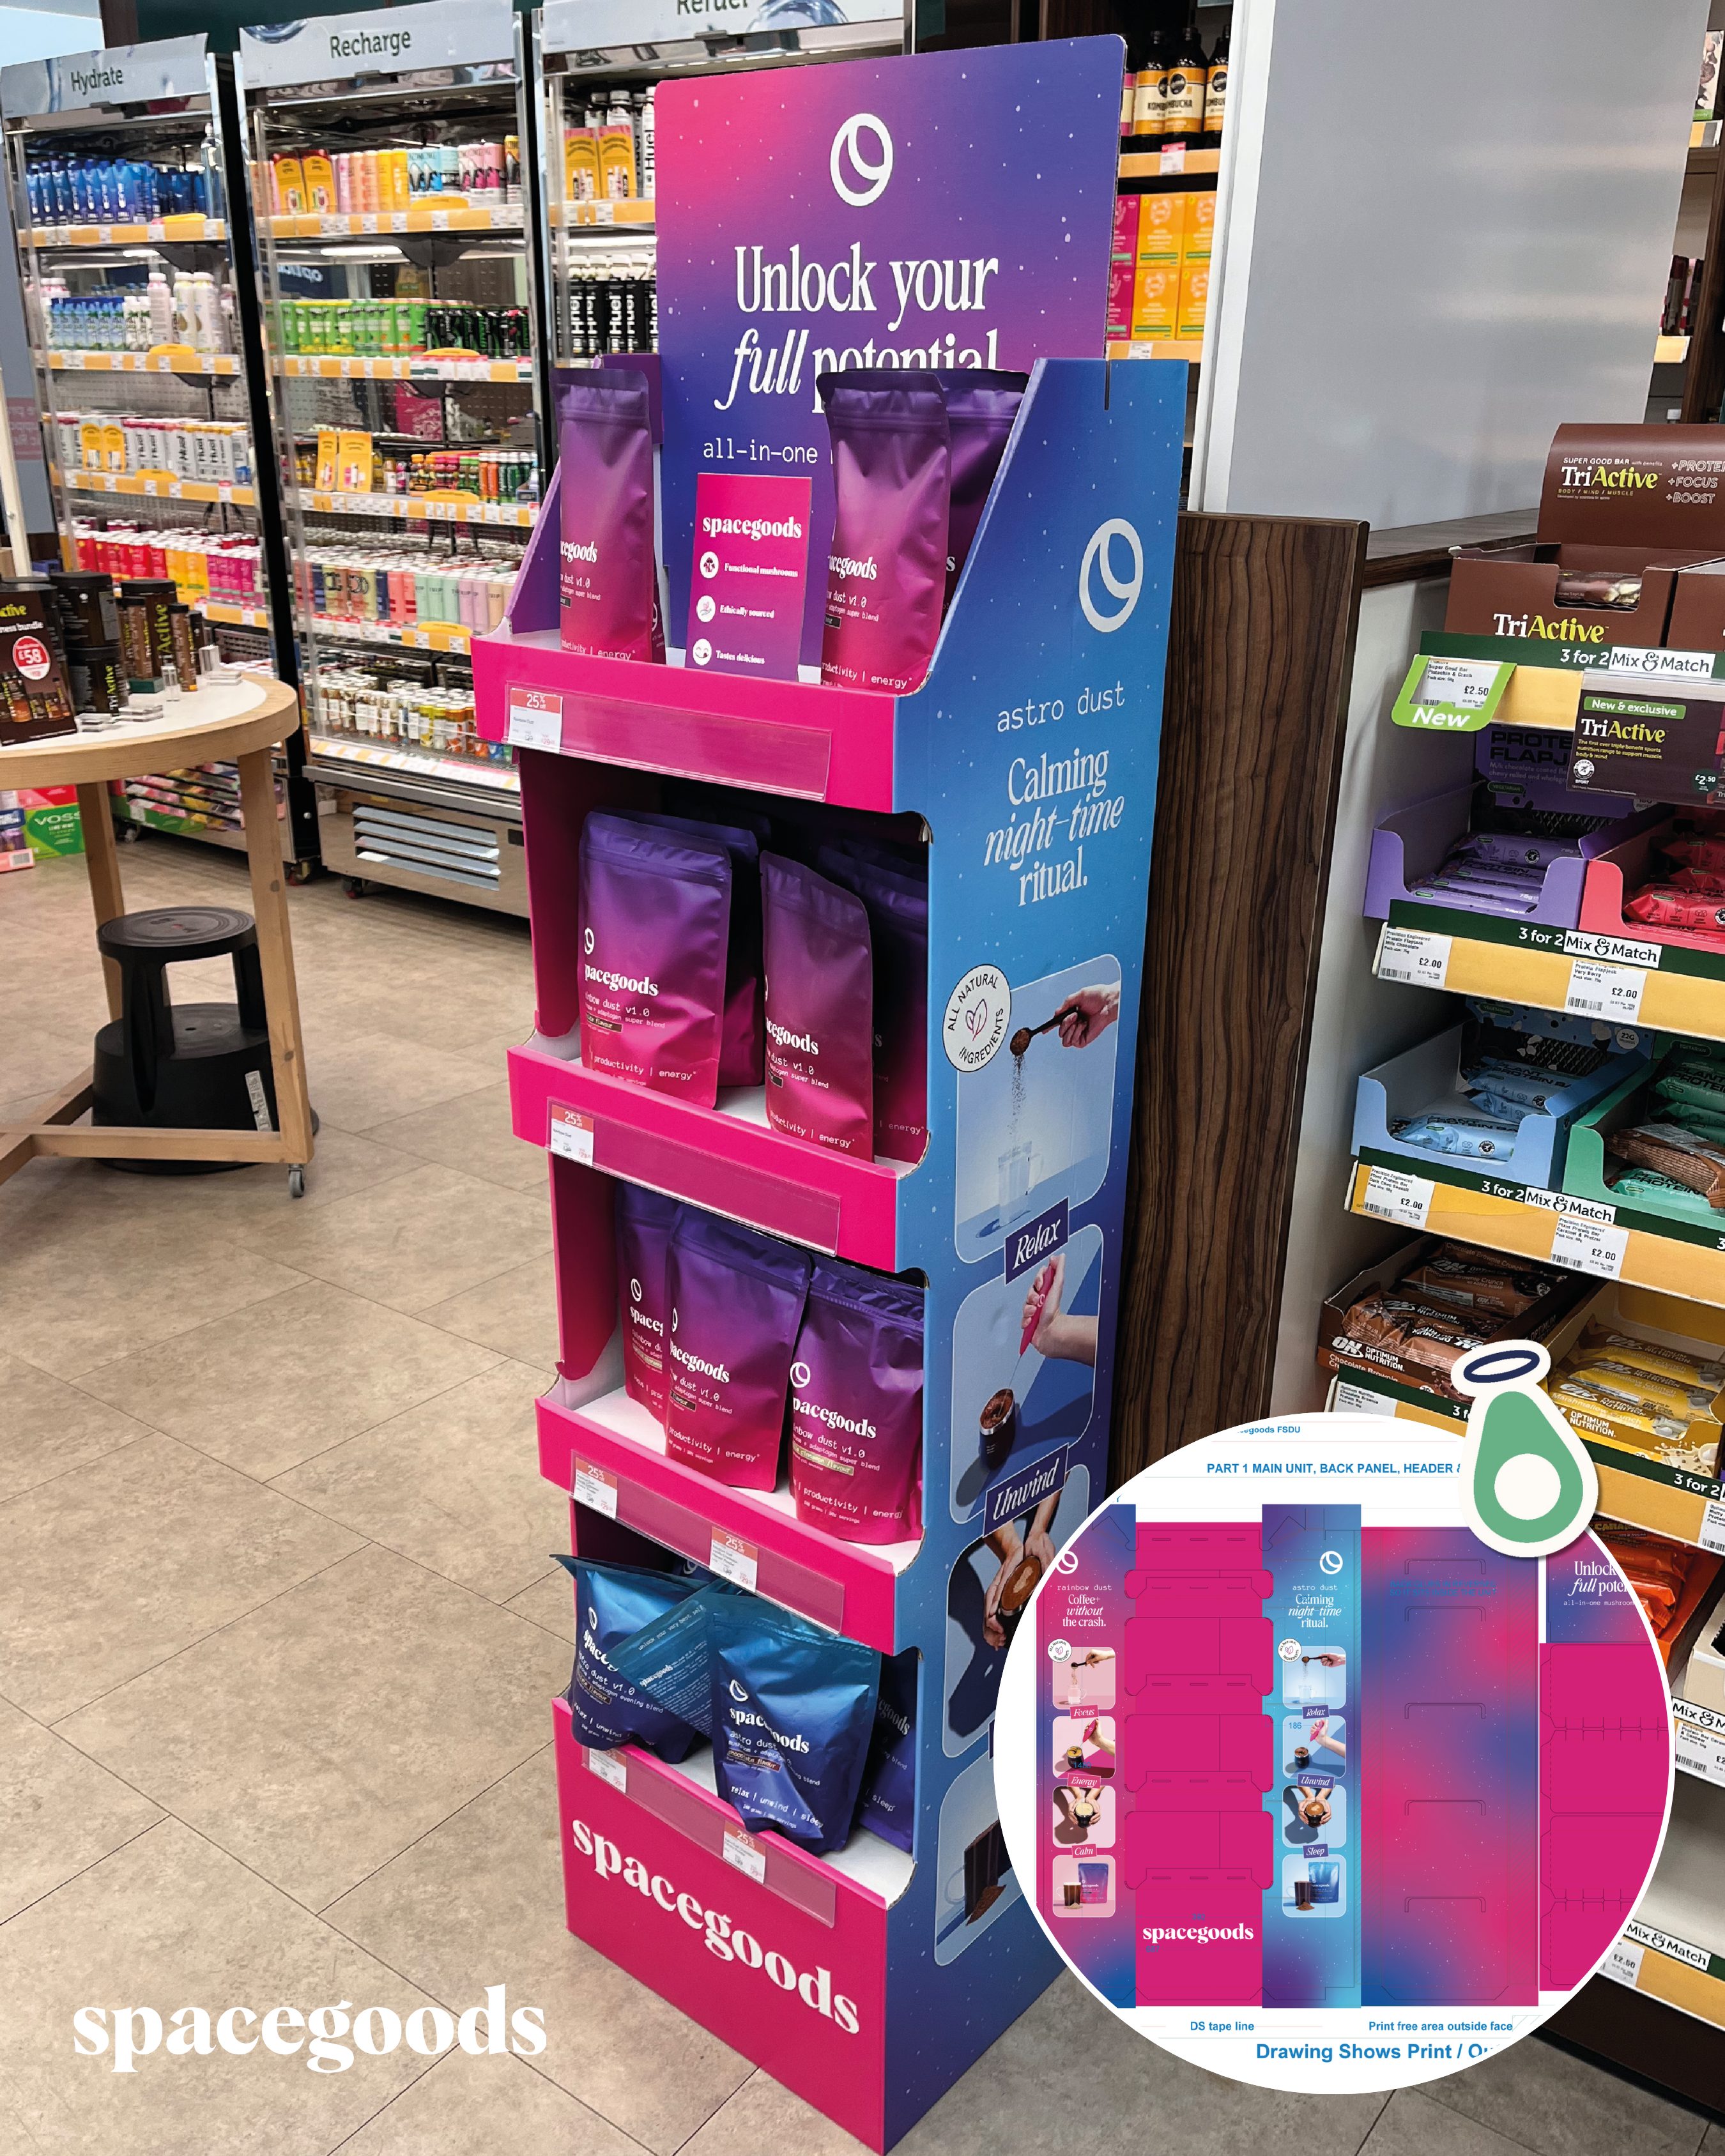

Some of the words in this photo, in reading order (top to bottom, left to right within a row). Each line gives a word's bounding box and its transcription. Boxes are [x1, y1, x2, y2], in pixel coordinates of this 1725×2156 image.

[330, 29, 412, 59] Recharge
[70, 66, 124, 93] Hydrate
[735, 242, 877, 314] Unlock
[889, 257, 999, 332] your
[610, 296, 622, 334] Huel
[714, 328, 809, 411] full
[703, 437, 818, 466] all-in-one
[1561, 466, 1659, 489] TriActive
[702, 516, 802, 541] spacegoods
[724, 562, 760, 574] Functional
[760, 566, 799, 577] mushrooms
[719, 604, 748, 616] Ethically
[748, 609, 774, 619] sourced
[849, 596, 867, 608] v1.0
[1493, 612, 1604, 643] TriActive
[716, 650, 736, 661] Tastes
[736, 653, 765, 664] delicious
[1560, 648, 1571, 663] 3
[1573, 650, 1597, 664] for
[1598, 651, 1609, 665] 2
[1611, 652, 1640, 668] Mix
[1642, 652, 1660, 671] &
[1660, 656, 1710, 673] Match
[1464, 685, 1489, 696] £2.50
[997, 698, 1064, 733] astro
[1077, 680, 1126, 715] dust
[1412, 707, 1471, 728] New
[1591, 699, 1616, 711] New
[1618, 702, 1626, 711] &
[1627, 703, 1677, 716] exclusive
[1491, 730, 1572, 751] PROTE
[1581, 718, 1666, 743] TriActive
[1489, 746, 1568, 767] FLAPJ
[1008, 747, 1110, 806] Calming
[983, 793, 1126, 871] night-time
[1018, 845, 1089, 907] ritual.
[1518, 927, 1528, 940] 3
[1530, 929, 1553, 944] for
[1554, 933, 1564, 947] 2
[1565, 935, 1593, 951] Mix
[1593, 938, 1611, 956] &
[1611, 943, 1658, 963] Match
[1418, 957, 1443, 969] £2.00
[585, 964, 659, 997] pacegoods
[947, 1006, 961, 1032] ALL
[957, 973, 1002, 1004] NATURAL
[1611, 987, 1638, 1000] £2.00
[602, 999, 621, 1012] dust
[625, 1005, 650, 1018] v1.0
[646, 1020, 666, 1028] blend
[958, 1006, 1005, 1066] INGREDIENTS
[594, 1055, 645, 1076] productivity
[792, 1061, 815, 1075] v1.0
[1400, 1197, 1423, 1210] £2.00
[1481, 1181, 1491, 1193] 3
[1493, 1183, 1514, 1197] for
[1515, 1189, 1524, 1202] 2
[1526, 1191, 1552, 1207] Mix
[1552, 1195, 1568, 1212] &
[1568, 1202, 1613, 1222] Match
[1011, 1218, 1061, 1271] Relax
[1591, 1248, 1616, 1261] £2.00
[670, 1338, 730, 1383] pacegoods
[1365, 1346, 1399, 1364] OPTIMUM
[679, 1375, 697, 1392] dust
[700, 1387, 720, 1402] v1.0
[793, 1396, 877, 1439] pacegoods
[1570, 1411, 1610, 1428] OPTIMUM
[818, 1435, 838, 1450] dust
[841, 1446, 866, 1459] v1.0
[861, 1460, 880, 1472] blend
[992, 1457, 1061, 1522] Unwind
[1673, 1473, 1683, 1485] 3
[1686, 1478, 1708, 1493] for
[1710, 1486, 1721, 1497] 2
[803, 1487, 859, 1514] productivity
[590, 1669, 608, 1686] dust
[612, 1682, 636, 1696] v1.0
[1673, 1702, 1698, 1720] Mix
[729, 1730, 753, 1746] astro
[756, 1738, 778, 1751] dust
[730, 1785, 750, 1799] relax
[759, 1796, 789, 1812] unwind
[573, 1817, 861, 2035] spacegoods
[1627, 1923, 1650, 1941] Mix
[1666, 1939, 1706, 1966] Match
